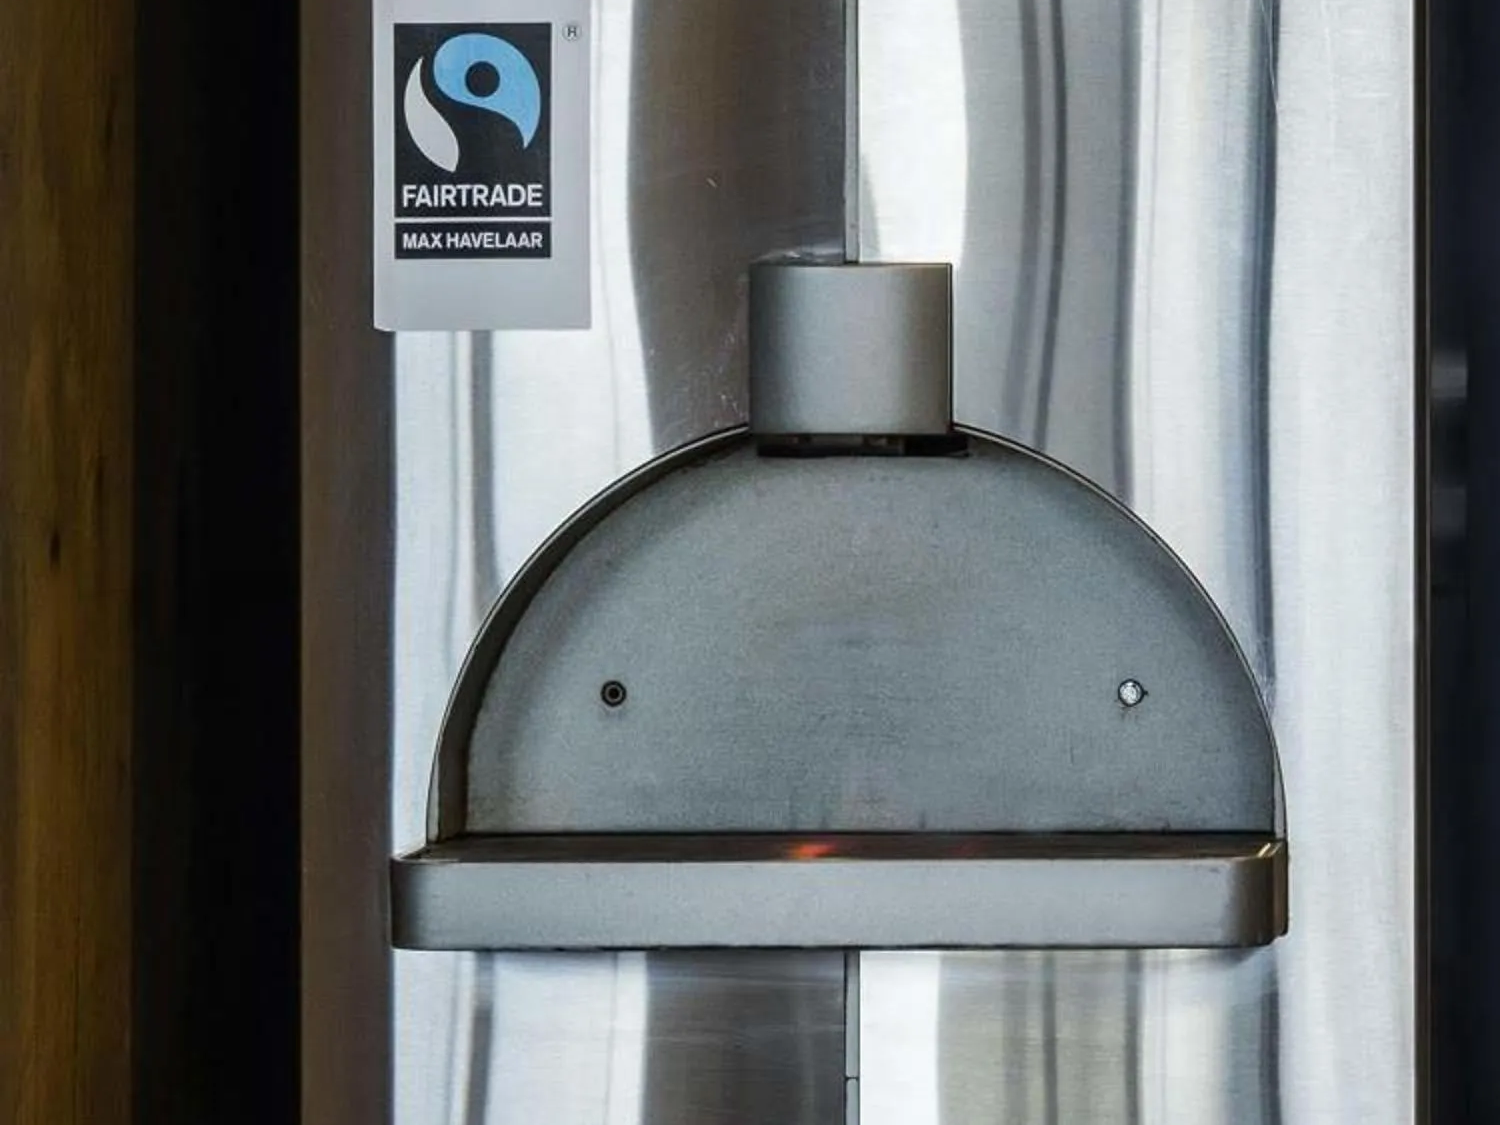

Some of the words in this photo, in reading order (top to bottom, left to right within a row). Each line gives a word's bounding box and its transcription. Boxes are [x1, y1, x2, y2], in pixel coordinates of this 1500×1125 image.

[402, 183, 543, 208] FAIRTRADE
[403, 232, 443, 250] MAX
[446, 231, 543, 249] HAVELAAR
